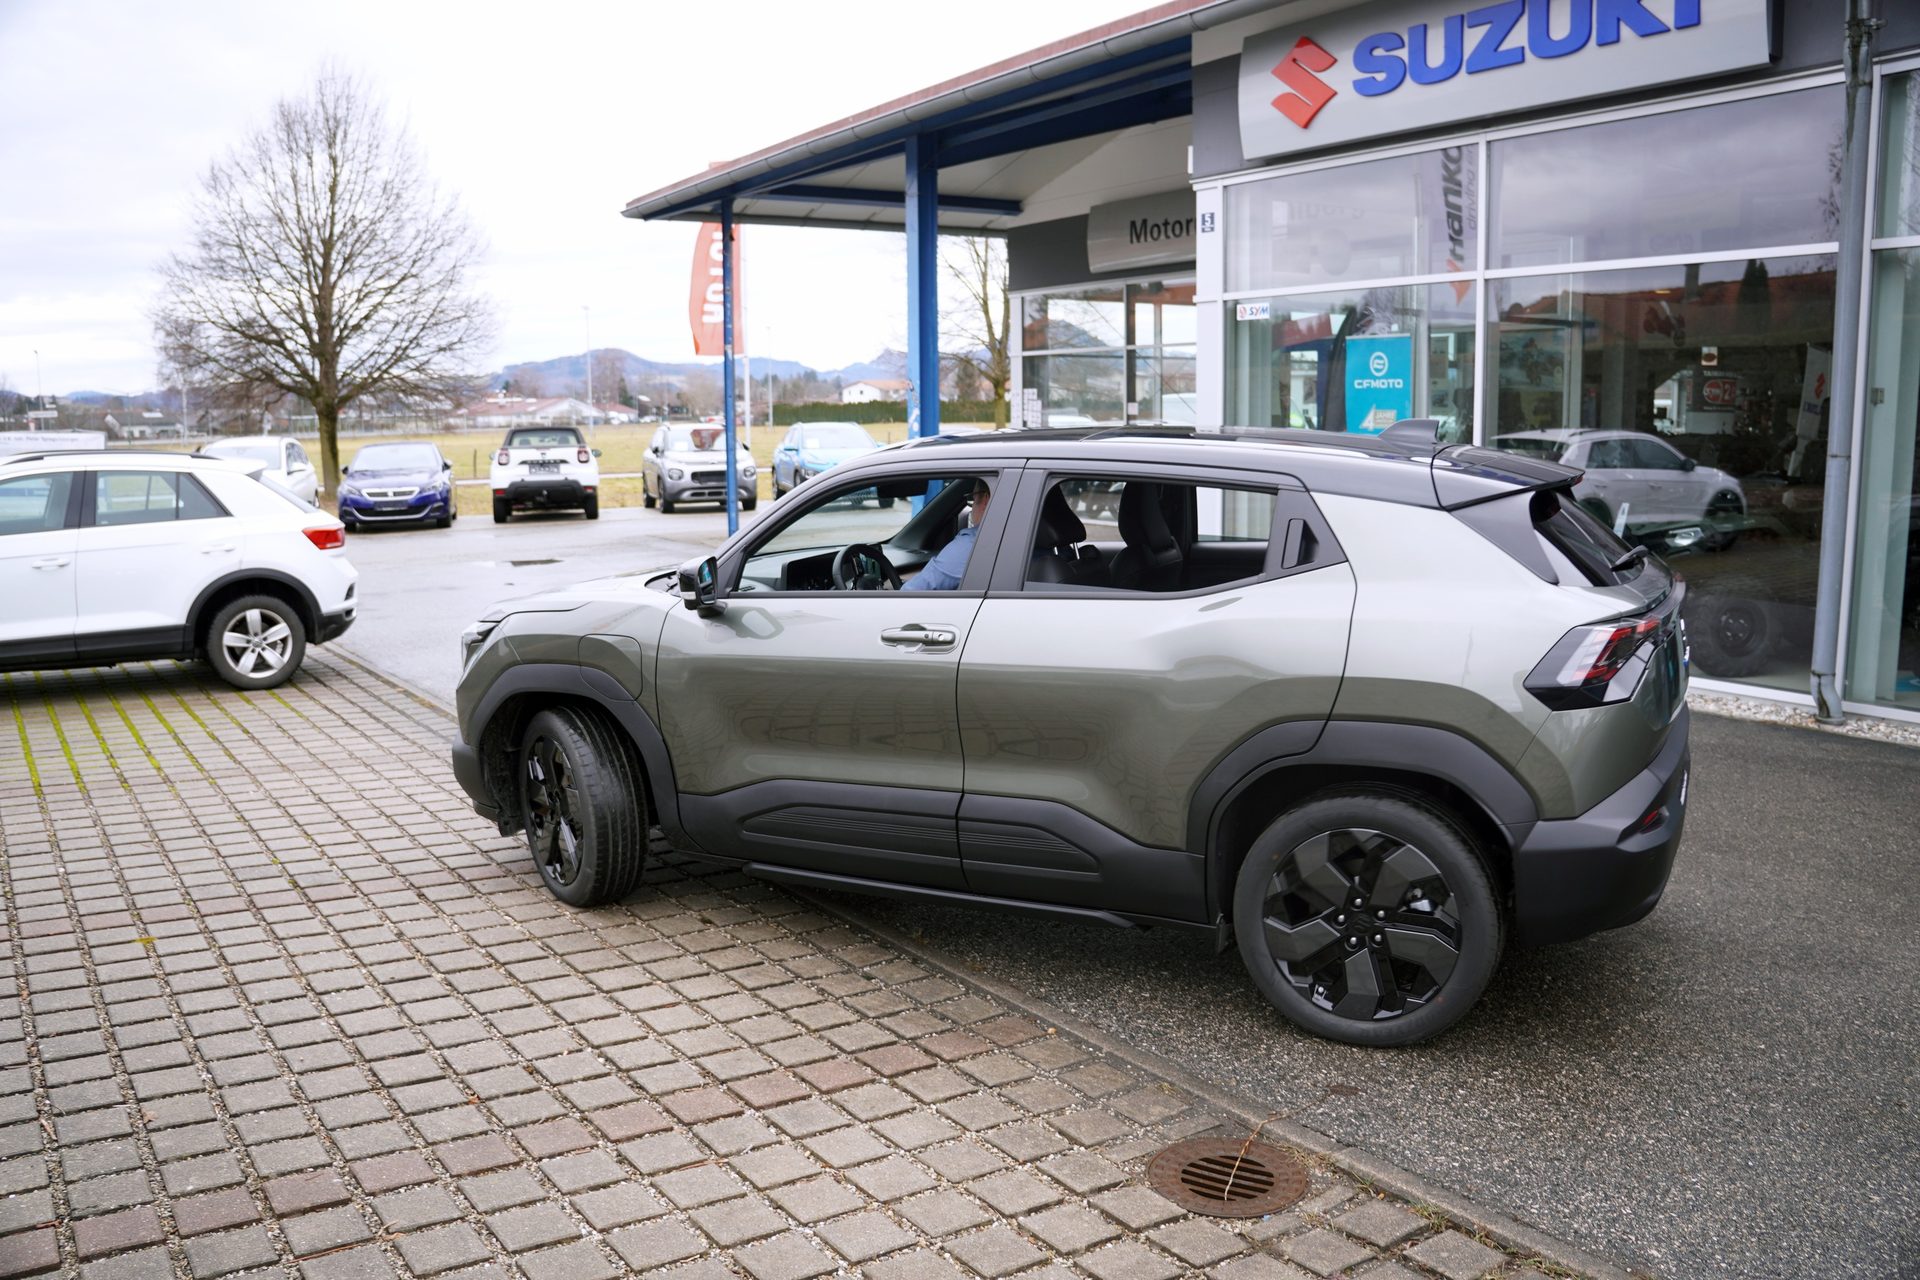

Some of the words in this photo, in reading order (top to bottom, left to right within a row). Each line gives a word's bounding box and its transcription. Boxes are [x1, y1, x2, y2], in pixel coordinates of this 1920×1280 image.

[1129, 217, 1197, 245] Motor
[1248, 306, 1268, 316] SYM
[1353, 379, 1404, 389] CFMOTO
